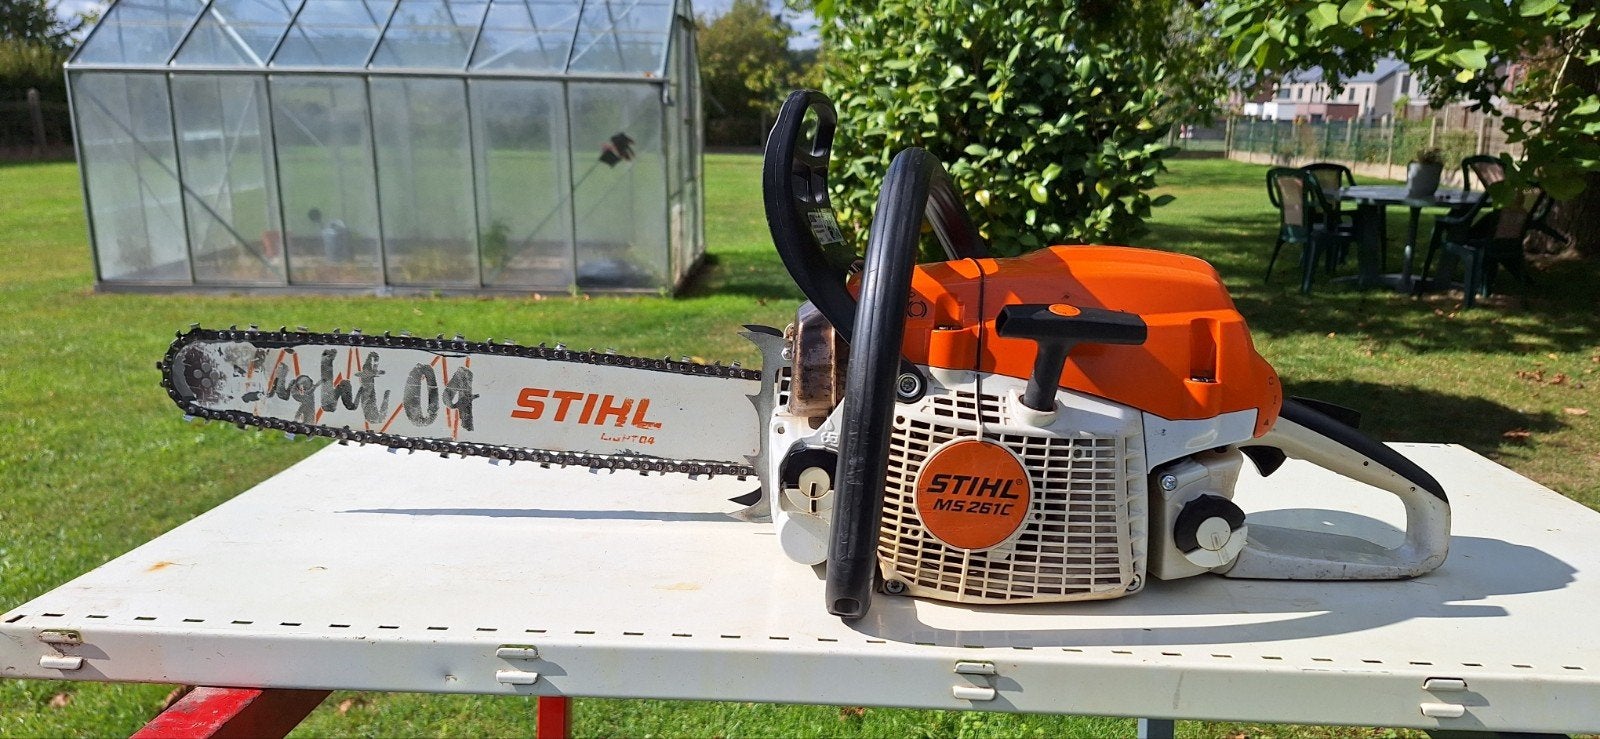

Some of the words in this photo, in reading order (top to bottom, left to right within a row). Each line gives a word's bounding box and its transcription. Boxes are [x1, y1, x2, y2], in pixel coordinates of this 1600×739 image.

[231, 347, 391, 424] ight
[510, 387, 662, 429] STIHL
[601, 432, 638, 442] LHT
[926, 473, 1019, 499] STIHL
[933, 498, 965, 512] MS
